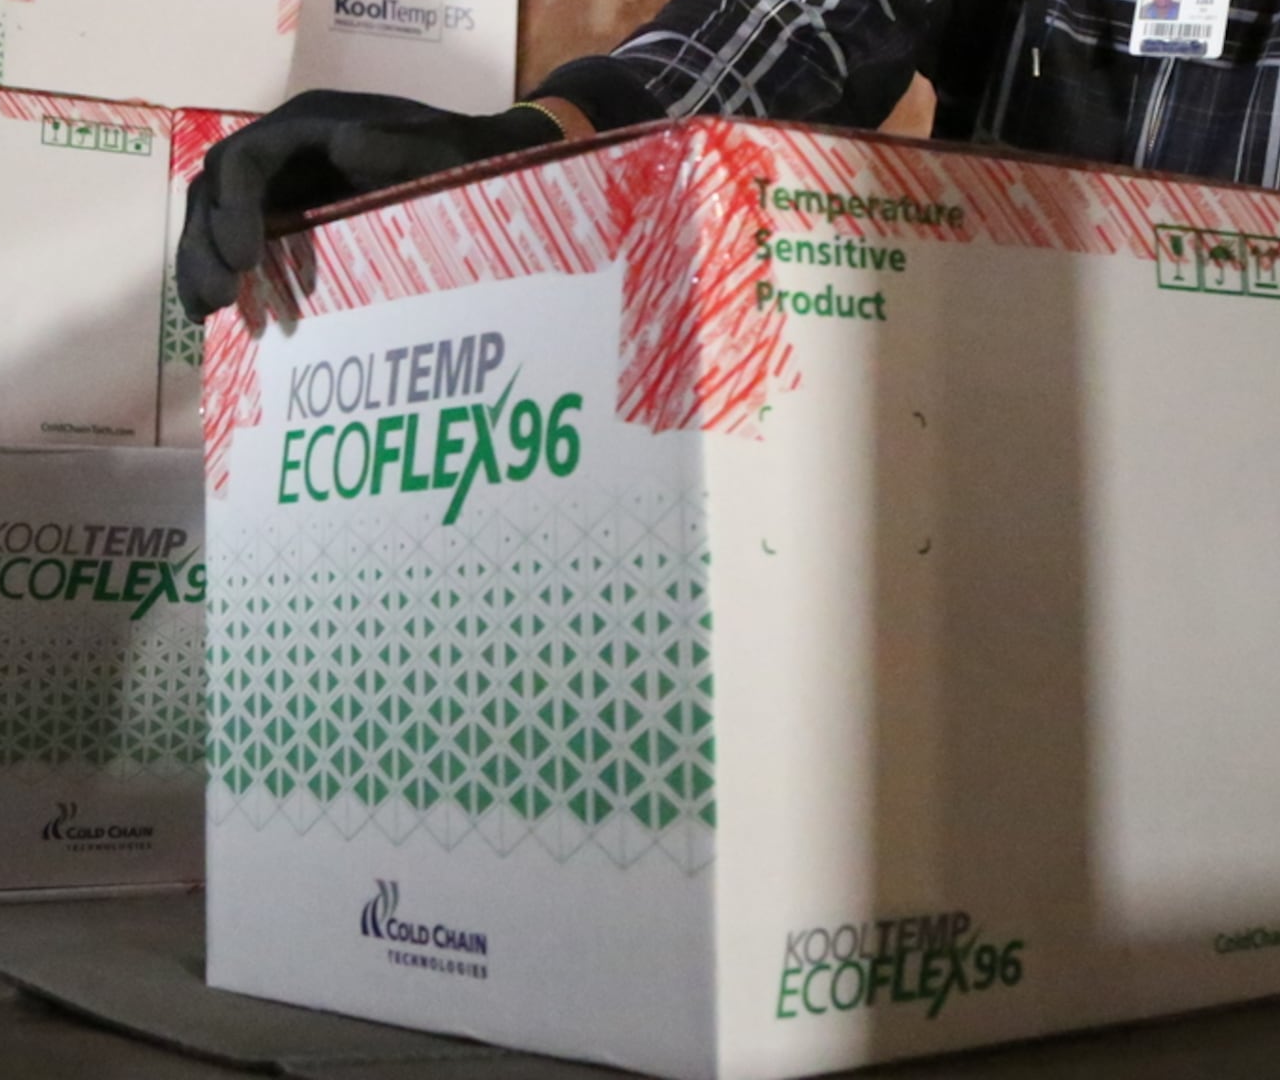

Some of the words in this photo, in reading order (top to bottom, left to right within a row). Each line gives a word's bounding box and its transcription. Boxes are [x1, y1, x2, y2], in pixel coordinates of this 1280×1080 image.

[444, 5, 474, 30] EPS
[754, 177, 964, 228] Temperature
[755, 228, 906, 272] Sensitive
[756, 281, 887, 321] Product
[286, 331, 505, 420] KOOLTEMP
[66, 827, 105, 839] COLD
[107, 825, 153, 838] CHAIN
[386, 918, 430, 945] COLD
[433, 924, 487, 955] CHAIN
[784, 911, 970, 968] KOOLTEMP
[388, 949, 487, 980] TECHNOLOGIES
